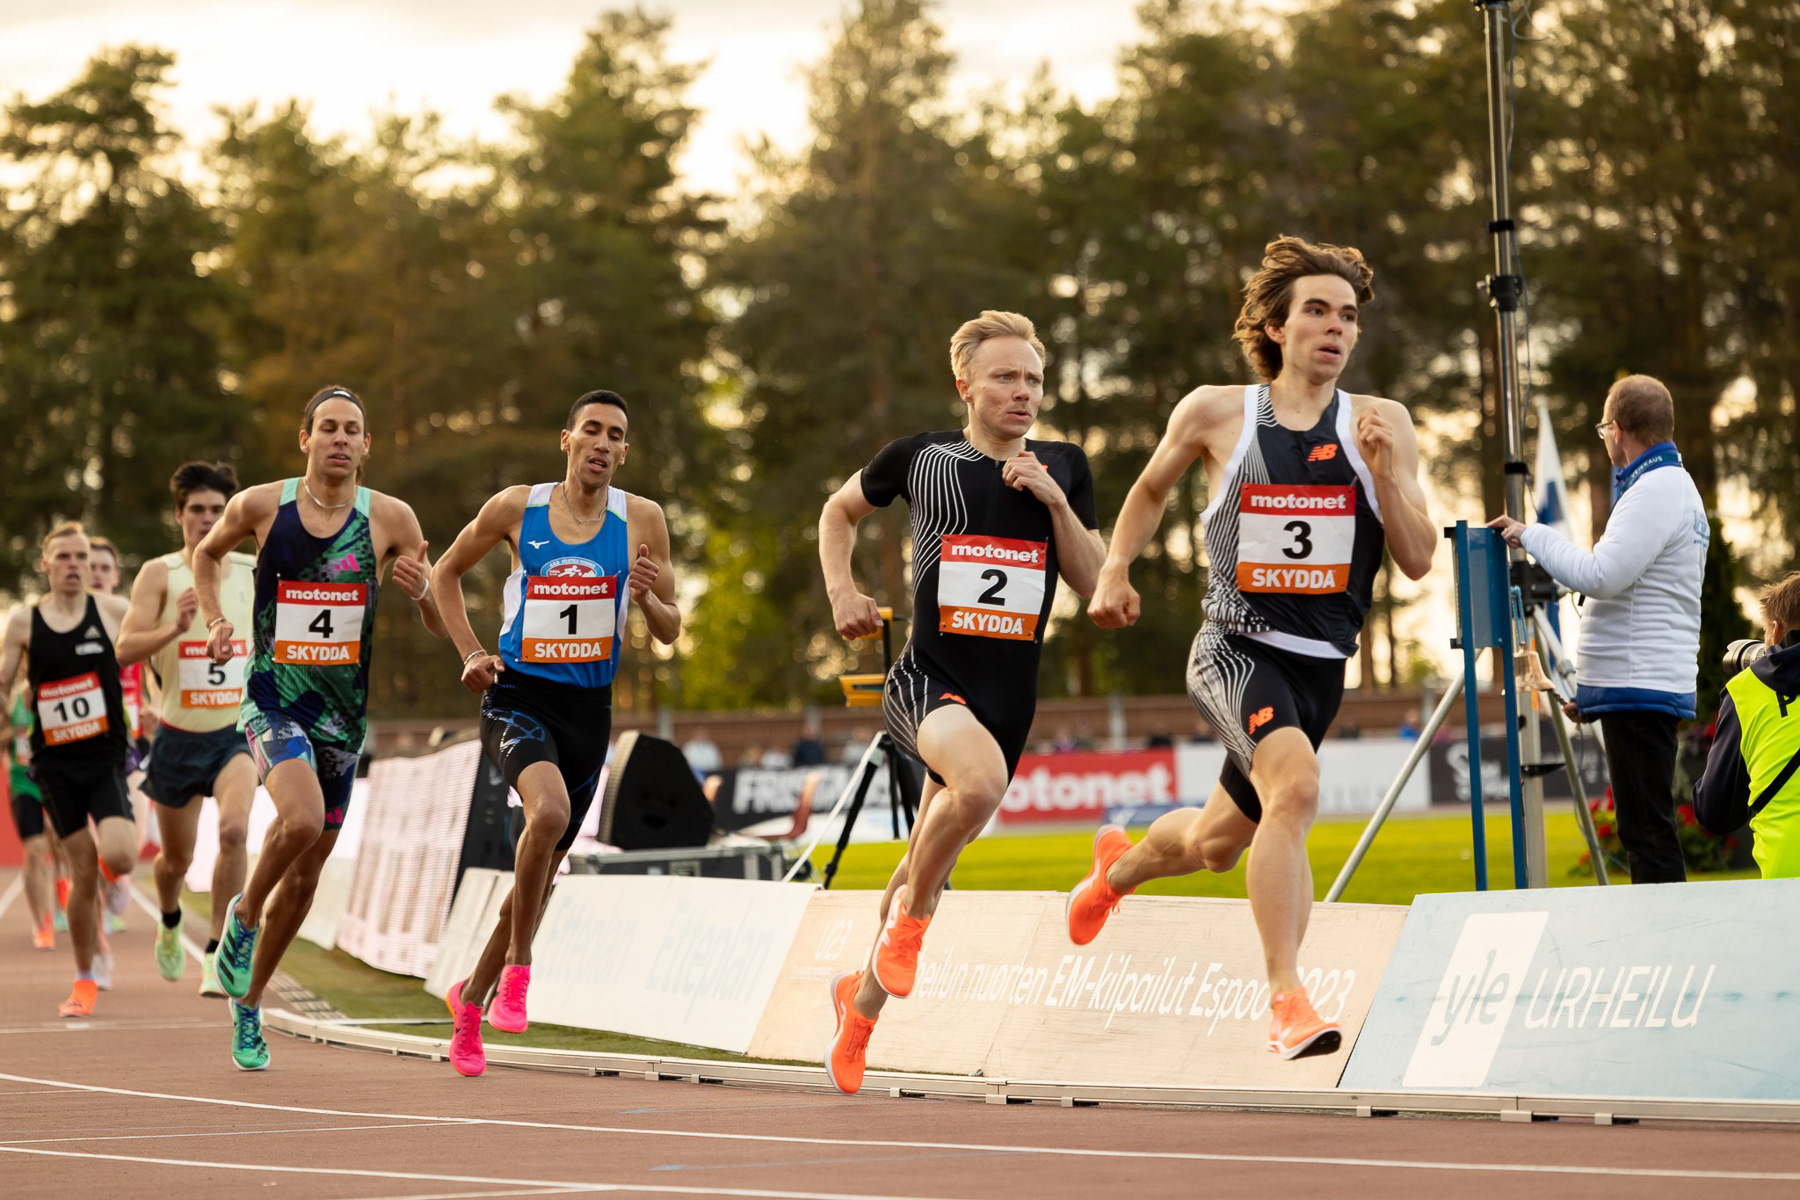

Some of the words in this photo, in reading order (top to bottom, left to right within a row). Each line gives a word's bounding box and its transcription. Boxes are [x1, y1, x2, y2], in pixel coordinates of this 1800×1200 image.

[1250, 493, 1347, 510] motonet
[1281, 520, 1313, 560] 3
[951, 544, 1039, 563] motonet
[533, 582, 609, 596] motonet
[977, 568, 1008, 607] 2
[1251, 568, 1337, 590] SKYDDA
[285, 588, 359, 602] motonet
[308, 608, 334, 639] 4
[559, 604, 578, 635] 1
[951, 610, 1024, 635] SKYDDA
[286, 644, 350, 661] SKYDDA
[534, 642, 602, 659] SKYDDA
[207, 662, 227, 687] 5
[40, 678, 94, 699] motonet
[189, 690, 240, 706] SKYDDA
[53, 697, 91, 723] 10
[52, 720, 102, 742] SKYDDA
[1001, 763, 1173, 812] otonet
[815, 919, 855, 961] U23
[970, 951, 1049, 1006] nuorten
[1044, 952, 1198, 1030] EM-kilpailut
[1188, 962, 1271, 1038] Espoo
[1296, 965, 1357, 1024] 023
[1430, 949, 1511, 1047] yle
[1524, 964, 1717, 1030] URHEILU
